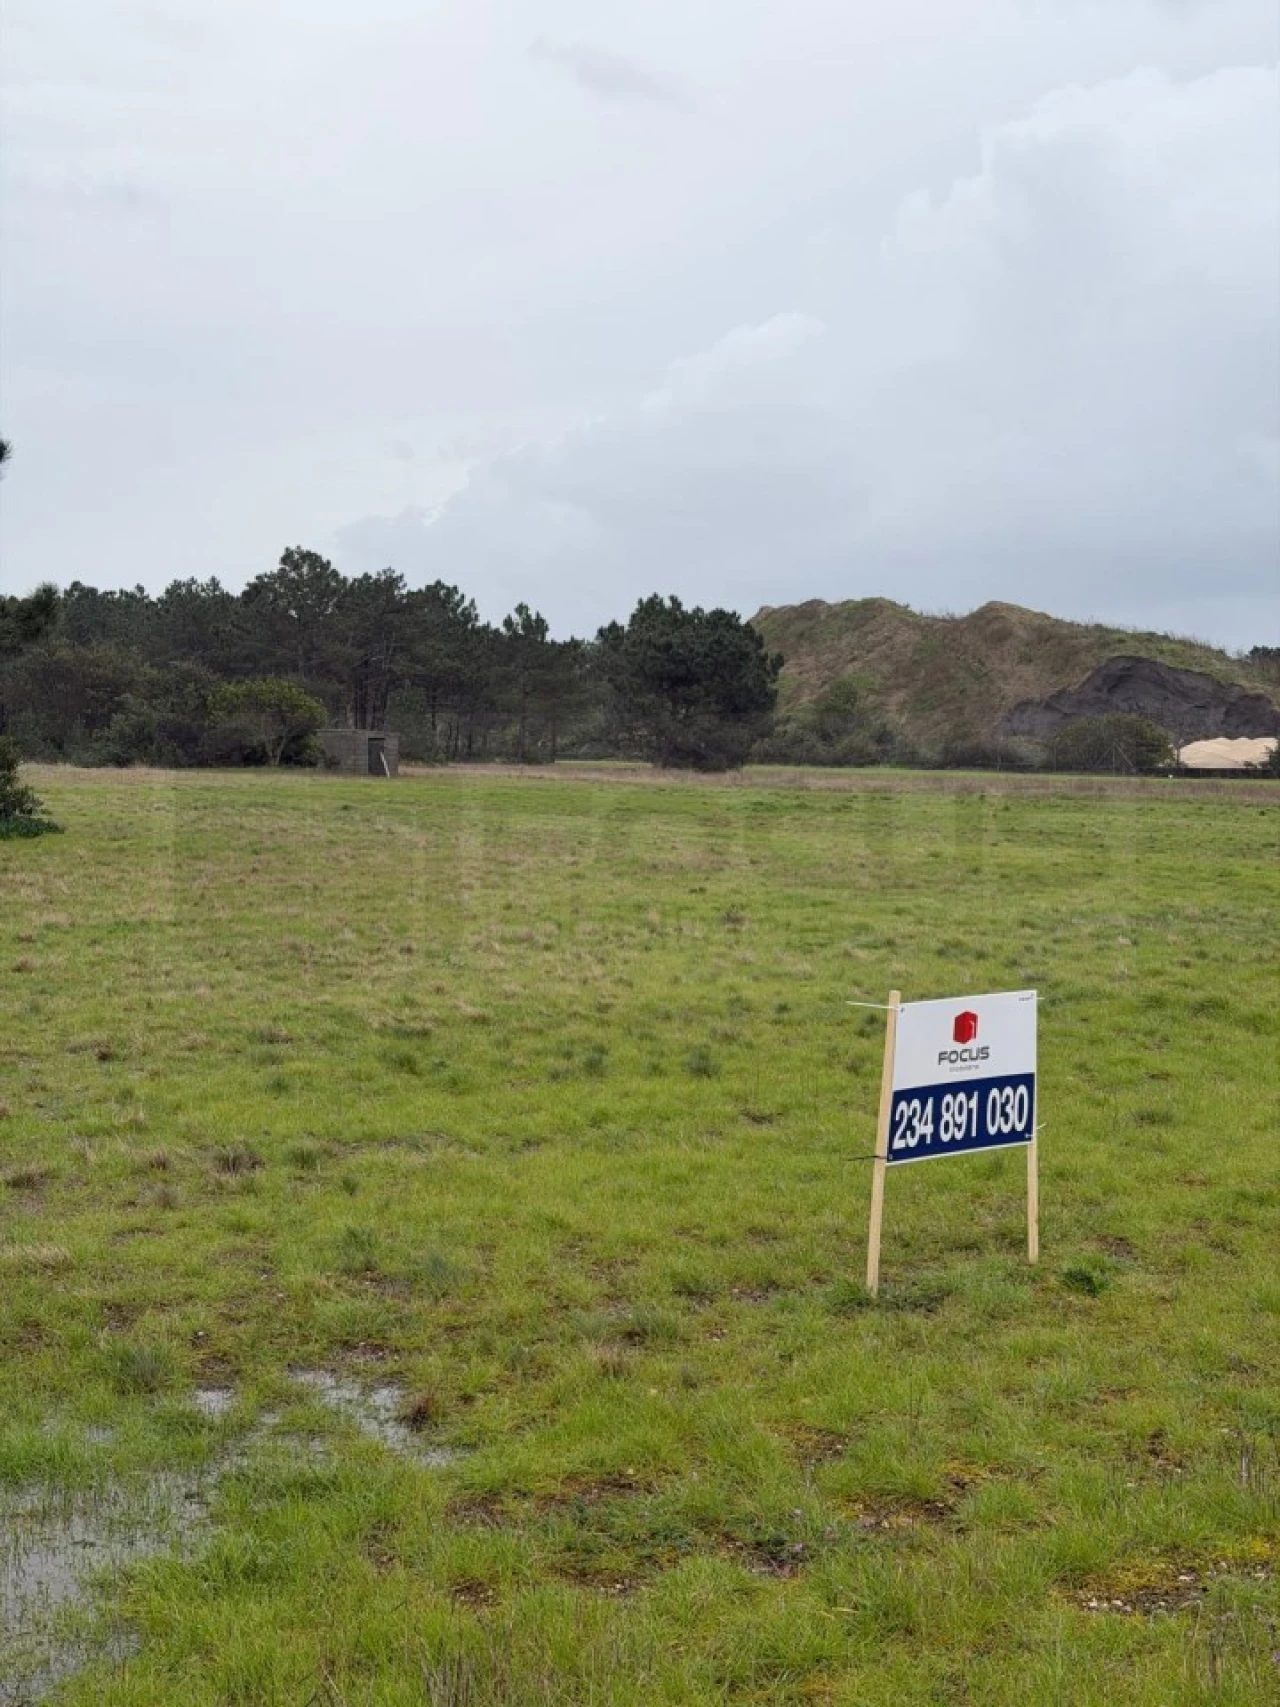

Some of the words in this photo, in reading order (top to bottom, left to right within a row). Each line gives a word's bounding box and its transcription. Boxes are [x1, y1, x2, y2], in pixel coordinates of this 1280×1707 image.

[938, 1046, 990, 1065] FOCUS
[892, 1097, 934, 1149] 234
[940, 1091, 979, 1142] 891
[987, 1084, 1028, 1135] 030
